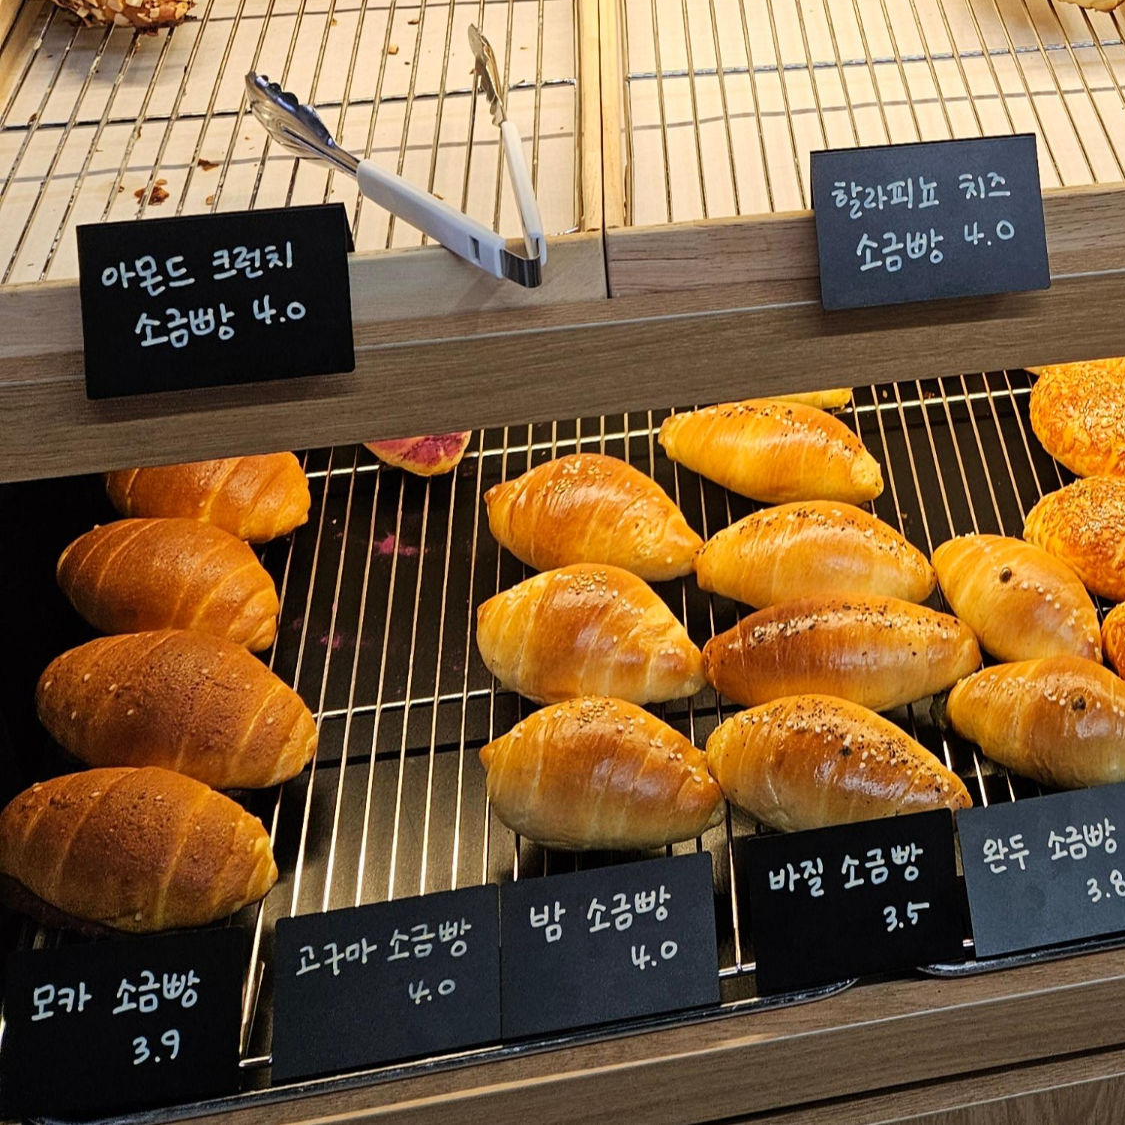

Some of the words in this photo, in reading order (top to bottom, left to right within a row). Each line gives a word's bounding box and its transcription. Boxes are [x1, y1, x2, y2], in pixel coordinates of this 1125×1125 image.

[831, 176, 940, 219] 할라피뇨
[959, 172, 1011, 199] 치즈
[101, 255, 195, 296] 아몬드
[212, 241, 293, 280] 크런치
[856, 228, 944, 272] 소금빵
[964, 220, 1015, 246] 4.0
[134, 303, 235, 348] 소금빵
[253, 295, 307, 324] 4.0
[768, 857, 825, 898] 바질
[841, 843, 924, 891] 소금빵
[983, 833, 1030, 874] 완두
[1047, 817, 1117, 861] 소금빵
[529, 901, 567, 943] 밤
[587, 885, 671, 934] 소금빵
[882, 901, 930, 933] 3.5
[296, 938, 378, 977] 고구마
[387, 917, 472, 962] 소금빵
[630, 940, 679, 971] 4.0
[31, 981, 93, 1022] 모카
[112, 969, 200, 1015] 소금빵
[408, 978, 456, 1005] 4.0
[132, 1028, 181, 1065] 3.9
